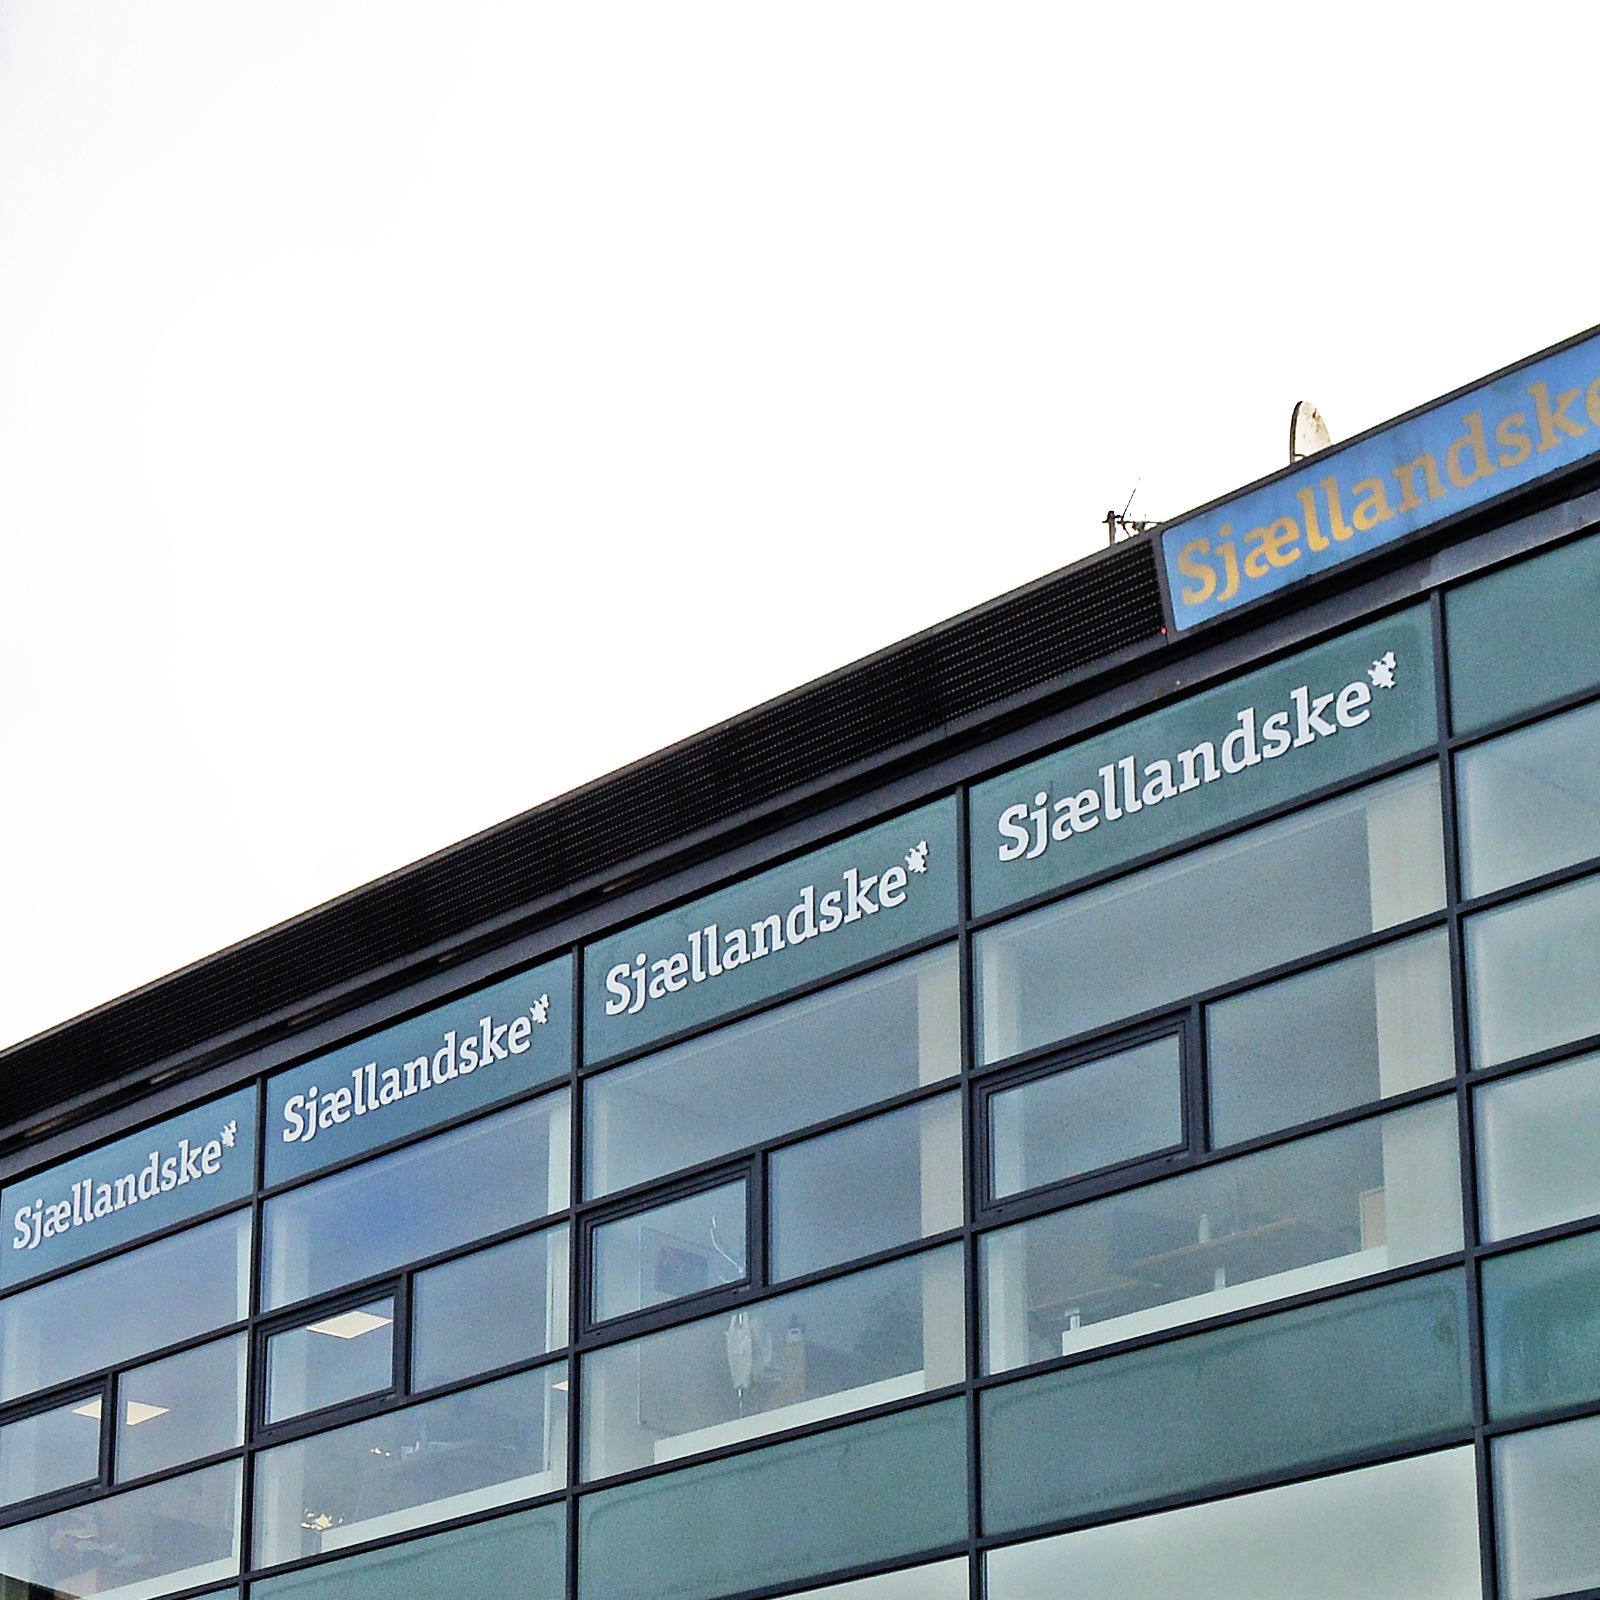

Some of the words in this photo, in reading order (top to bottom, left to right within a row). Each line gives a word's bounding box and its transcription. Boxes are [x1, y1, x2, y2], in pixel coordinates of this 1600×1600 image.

[997, 681, 1370, 861] Sjællandske
[605, 866, 908, 1016] Sjællandske
[283, 1016, 532, 1144] Sjællandske
[12, 1138, 222, 1251] Sjællandske
